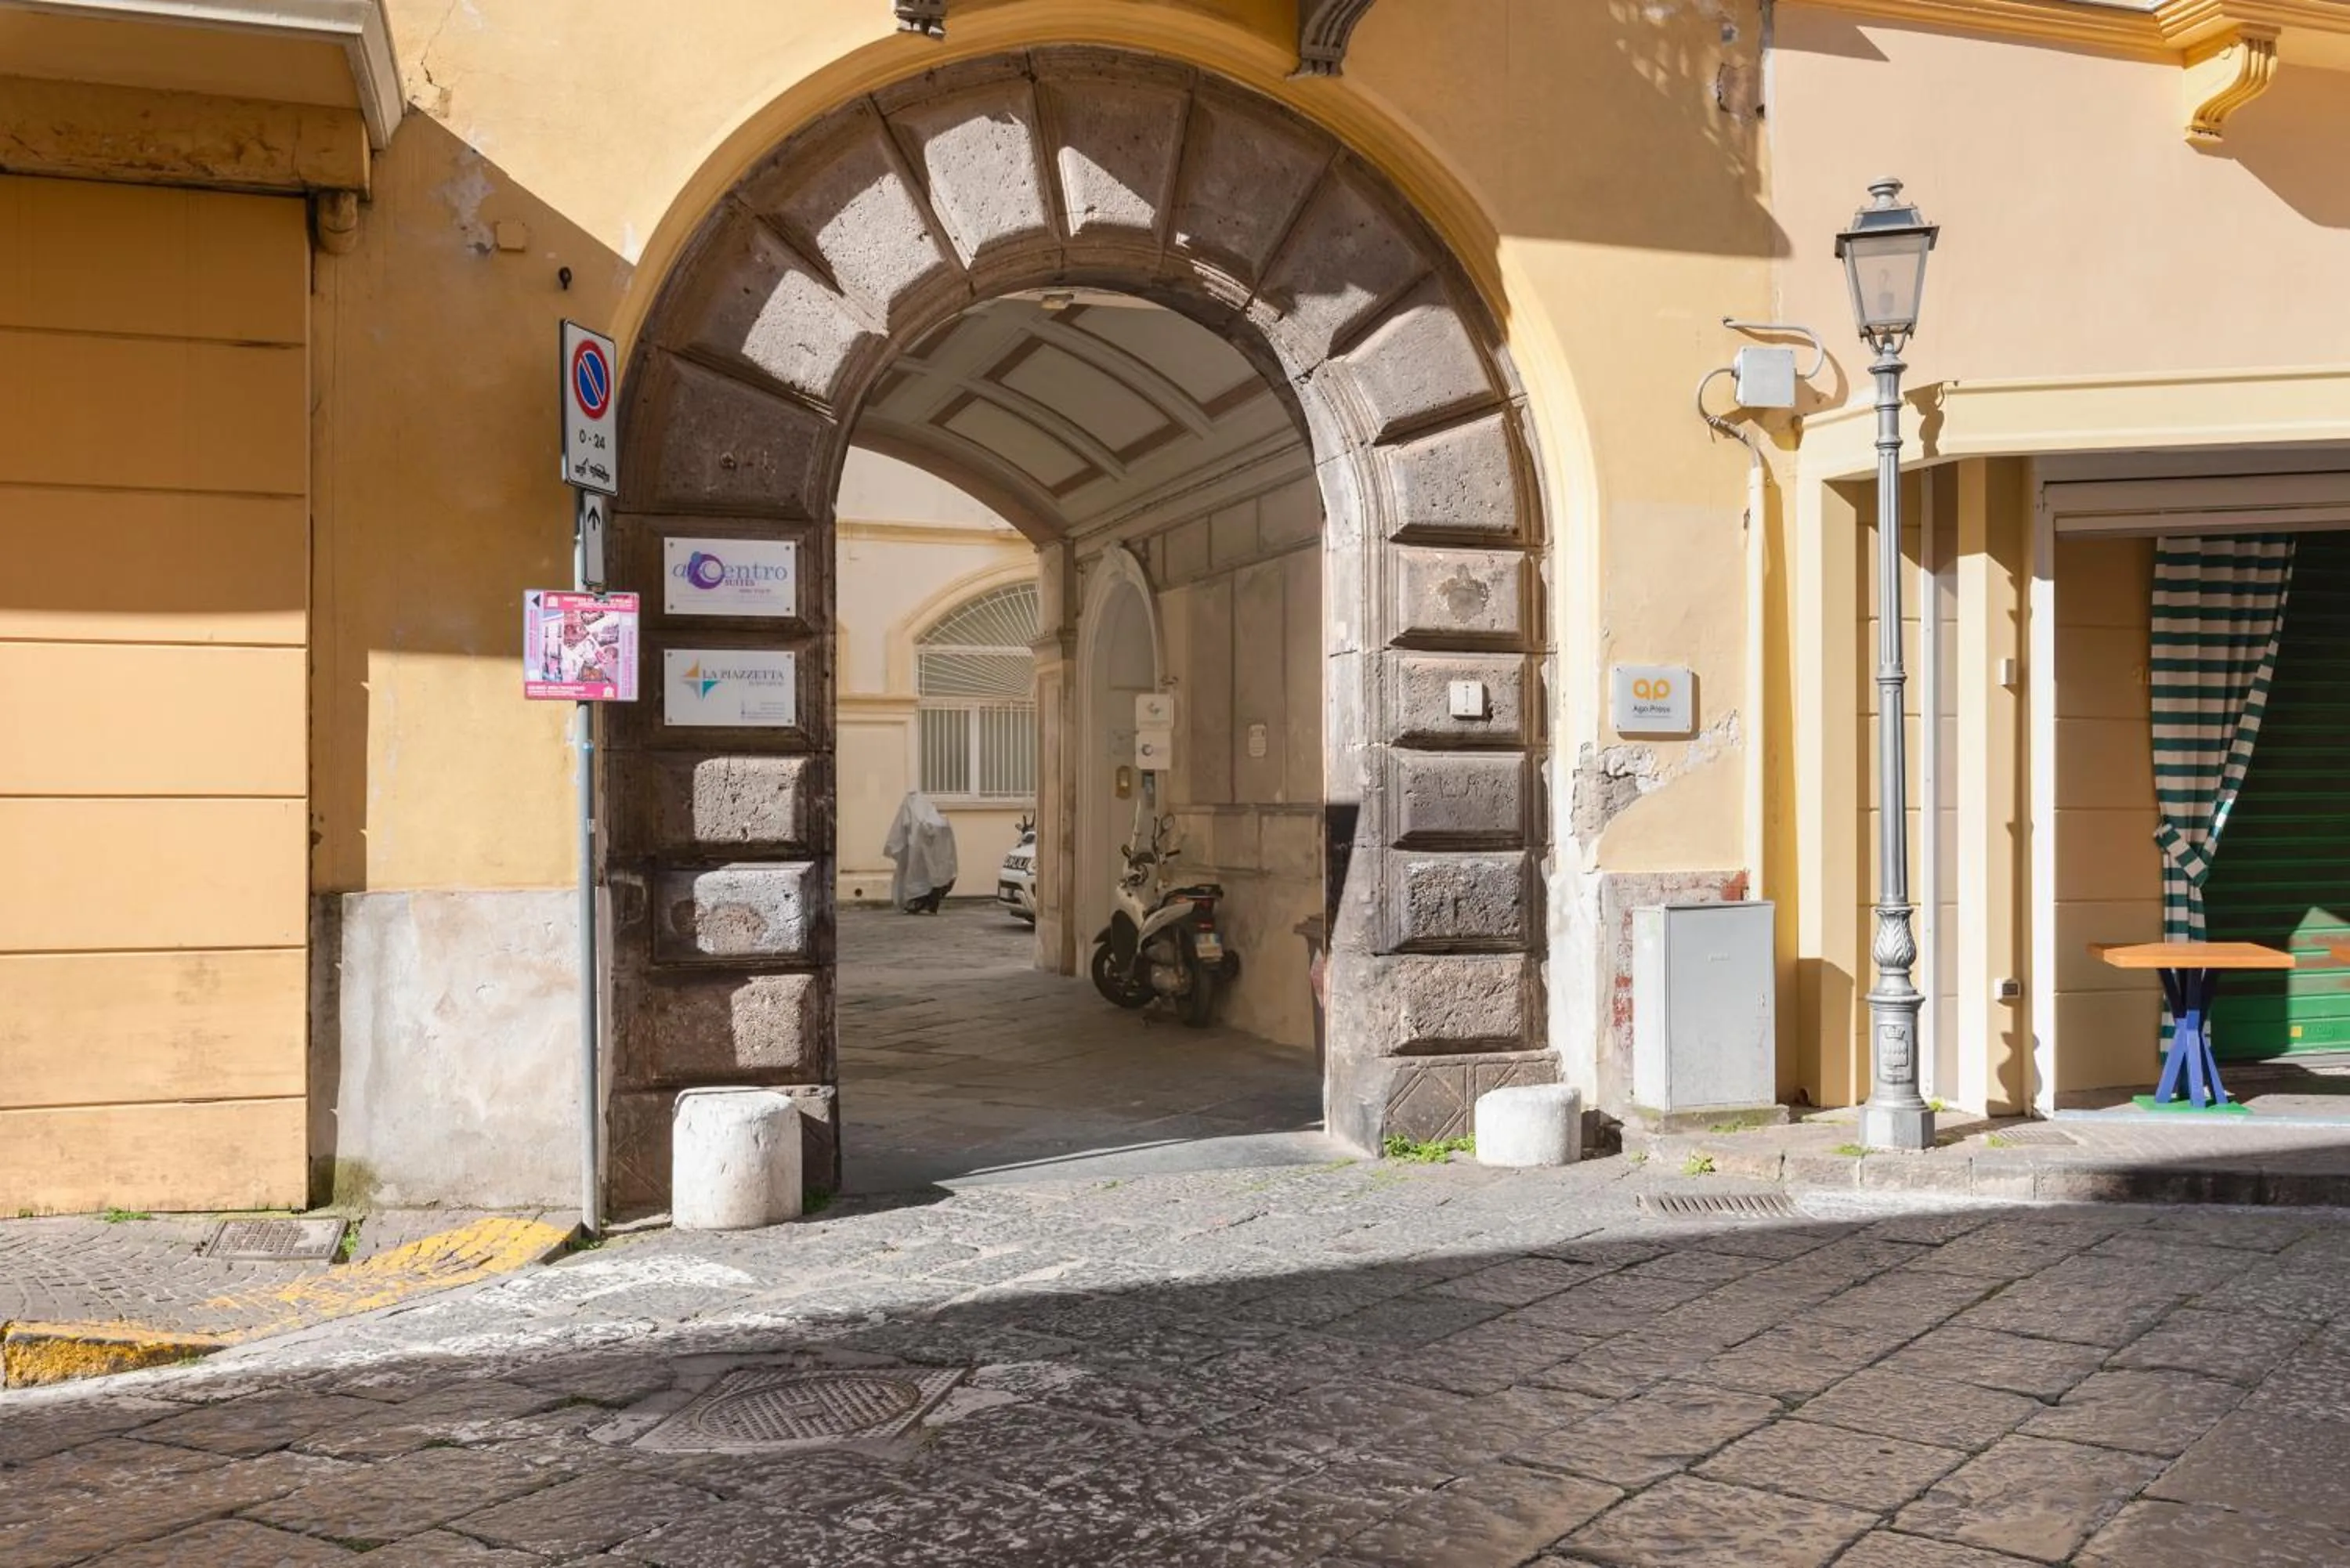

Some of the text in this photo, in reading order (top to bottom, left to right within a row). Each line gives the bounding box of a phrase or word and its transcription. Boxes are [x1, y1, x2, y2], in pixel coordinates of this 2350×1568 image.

[580, 428, 587, 444] 0
[594, 433, 606, 450] 24
[703, 669, 785, 680] LA PIAZZETTA
